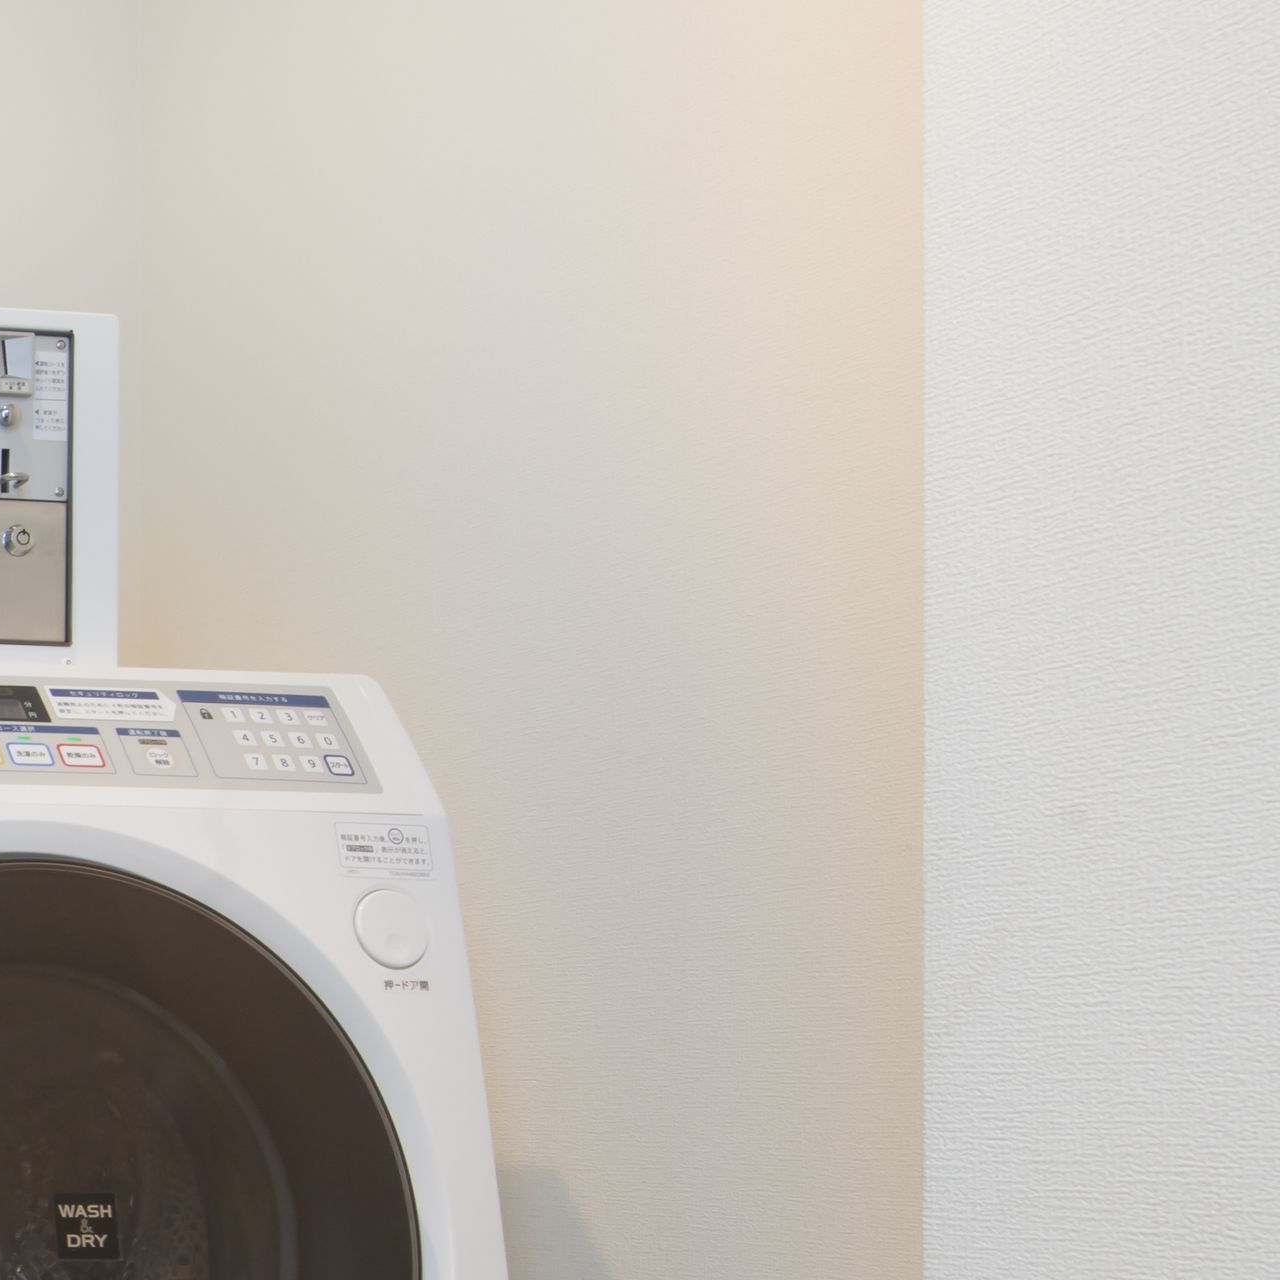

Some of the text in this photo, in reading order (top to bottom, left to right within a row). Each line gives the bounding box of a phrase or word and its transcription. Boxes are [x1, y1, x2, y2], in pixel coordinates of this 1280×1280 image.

[258, 712, 265, 720] 2
[286, 713, 293, 721] 3
[270, 735, 277, 743] 5
[298, 736, 305, 744] 6
[324, 737, 332, 745] 0
[252, 757, 259, 765] 7
[280, 759, 288, 767] 8
[308, 760, 316, 768] 9
[58, 1205, 112, 1217] WASH
[81, 1219, 94, 1233] &
[67, 1234, 108, 1247] DRY
